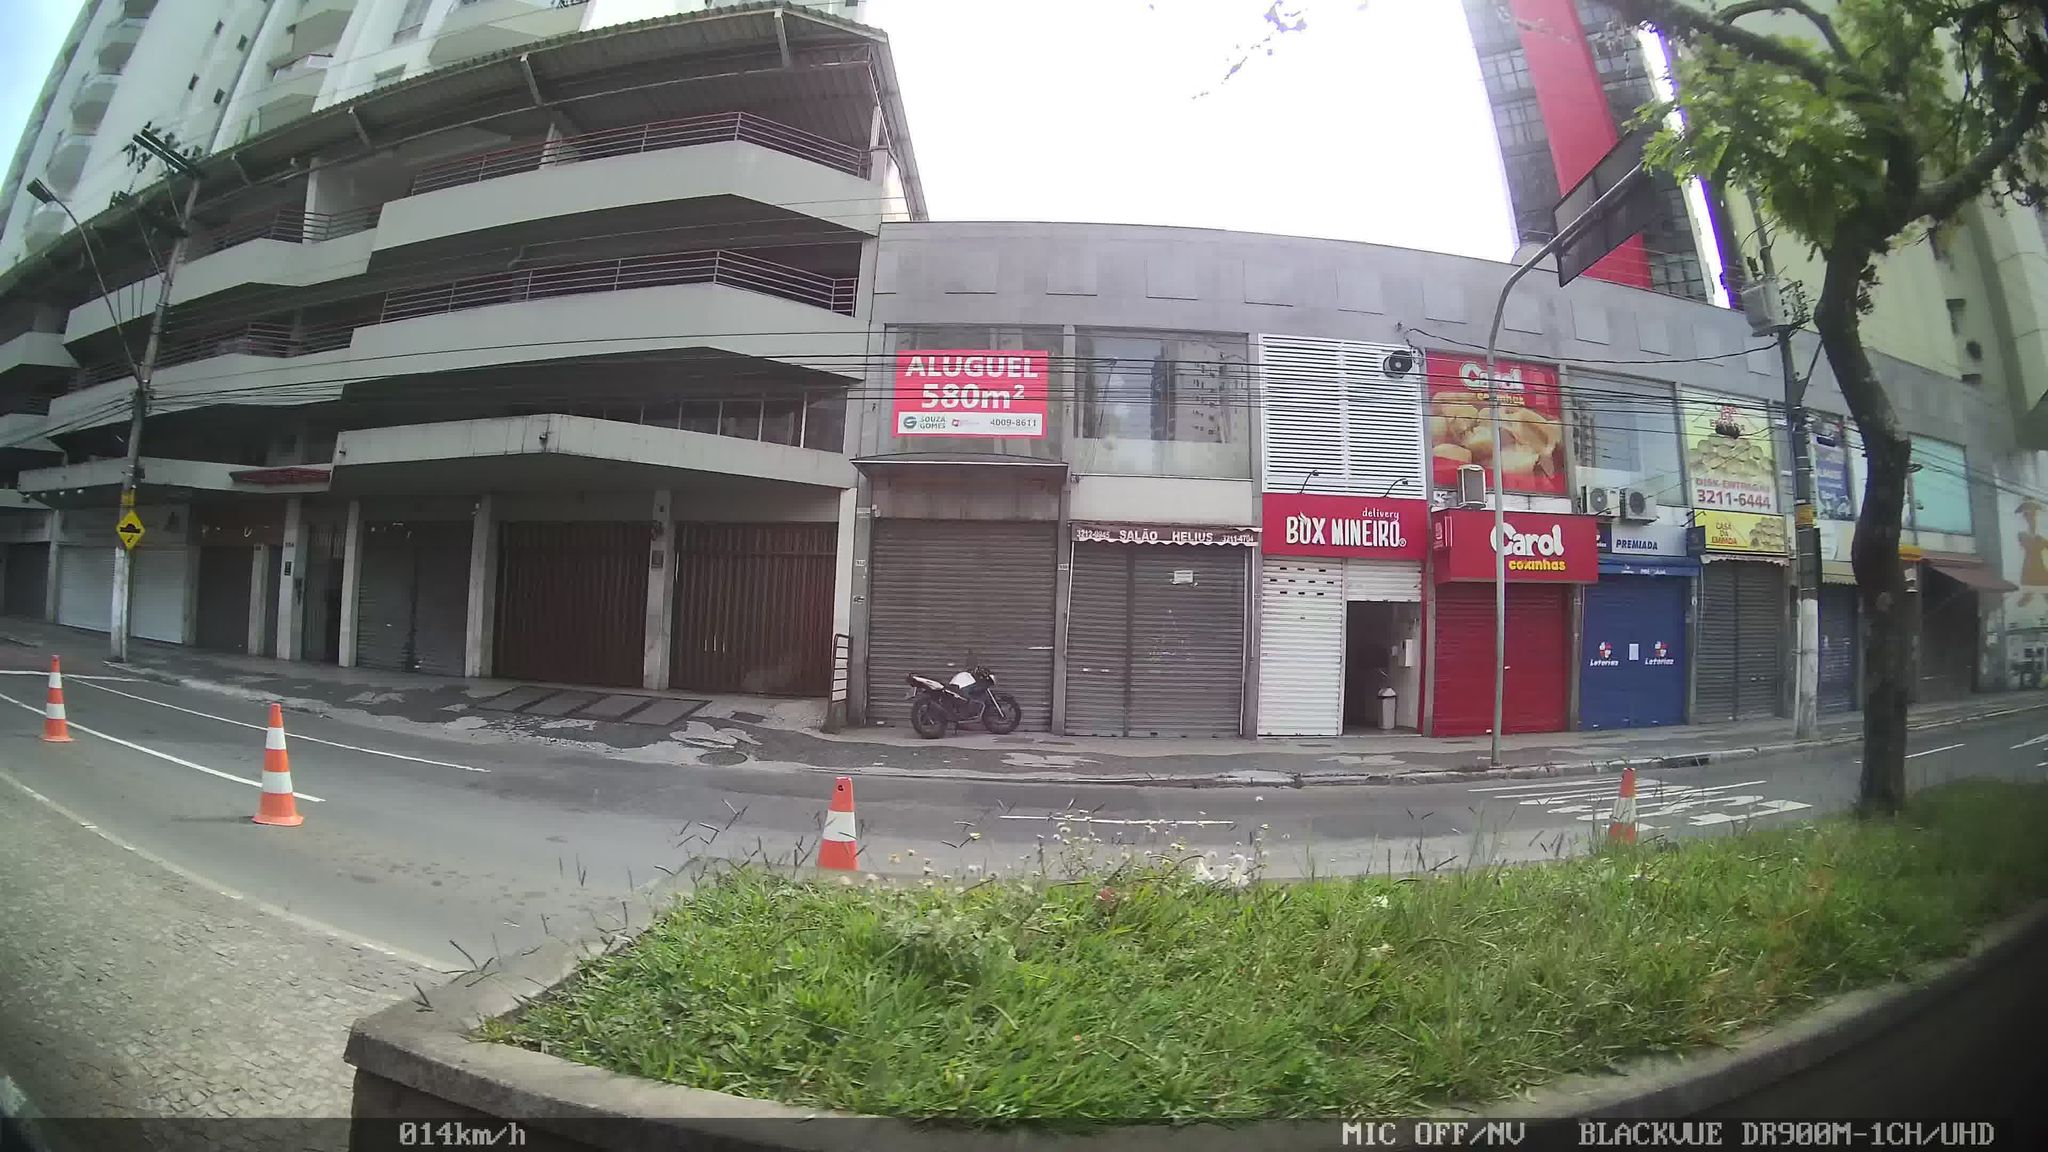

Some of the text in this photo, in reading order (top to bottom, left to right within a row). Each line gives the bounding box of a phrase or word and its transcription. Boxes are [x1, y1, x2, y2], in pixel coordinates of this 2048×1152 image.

[905, 356, 1040, 378] ALUGUEL
[990, 419, 1037, 427] 4009-8611
[1697, 489, 1771, 509] 3211-6444
[1362, 507, 1399, 522] delivery
[1119, 528, 1158, 541] SALÃO
[1172, 532, 1214, 543] HELIUS
[1286, 512, 1326, 545] BOX
[1331, 518, 1399, 547] MINEIRO
[1490, 522, 1564, 556] Carol
[1616, 539, 1658, 550] PREMIADA
[1508, 559, 1566, 571] coxinhas
[1590, 659, 1619, 667] Loterias
[1644, 658, 1674, 666] Loterias
